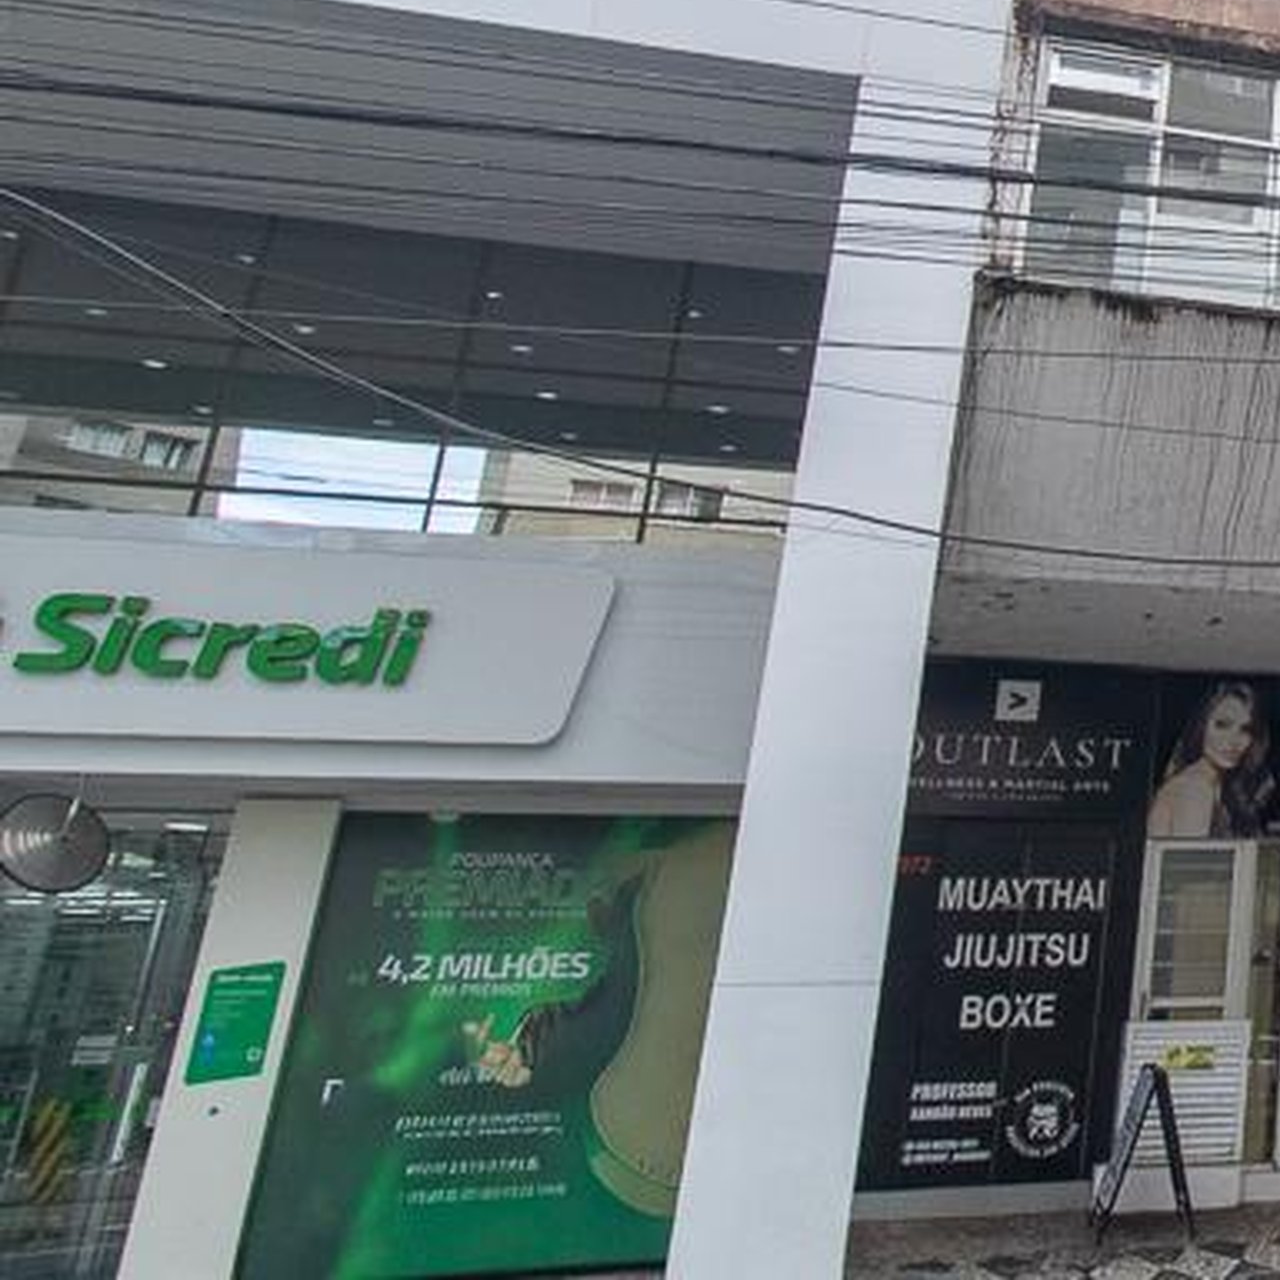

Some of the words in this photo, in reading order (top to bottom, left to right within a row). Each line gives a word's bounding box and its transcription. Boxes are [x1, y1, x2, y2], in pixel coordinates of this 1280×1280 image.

[12, 592, 434, 688] Sicredi
[938, 877, 1106, 911] MUAYTHAI
[377, 954, 431, 985] 4,2
[436, 945, 591, 980] MILHÕES
[943, 933, 1090, 968] JIUJITSU
[959, 993, 1057, 1030] BOXE
